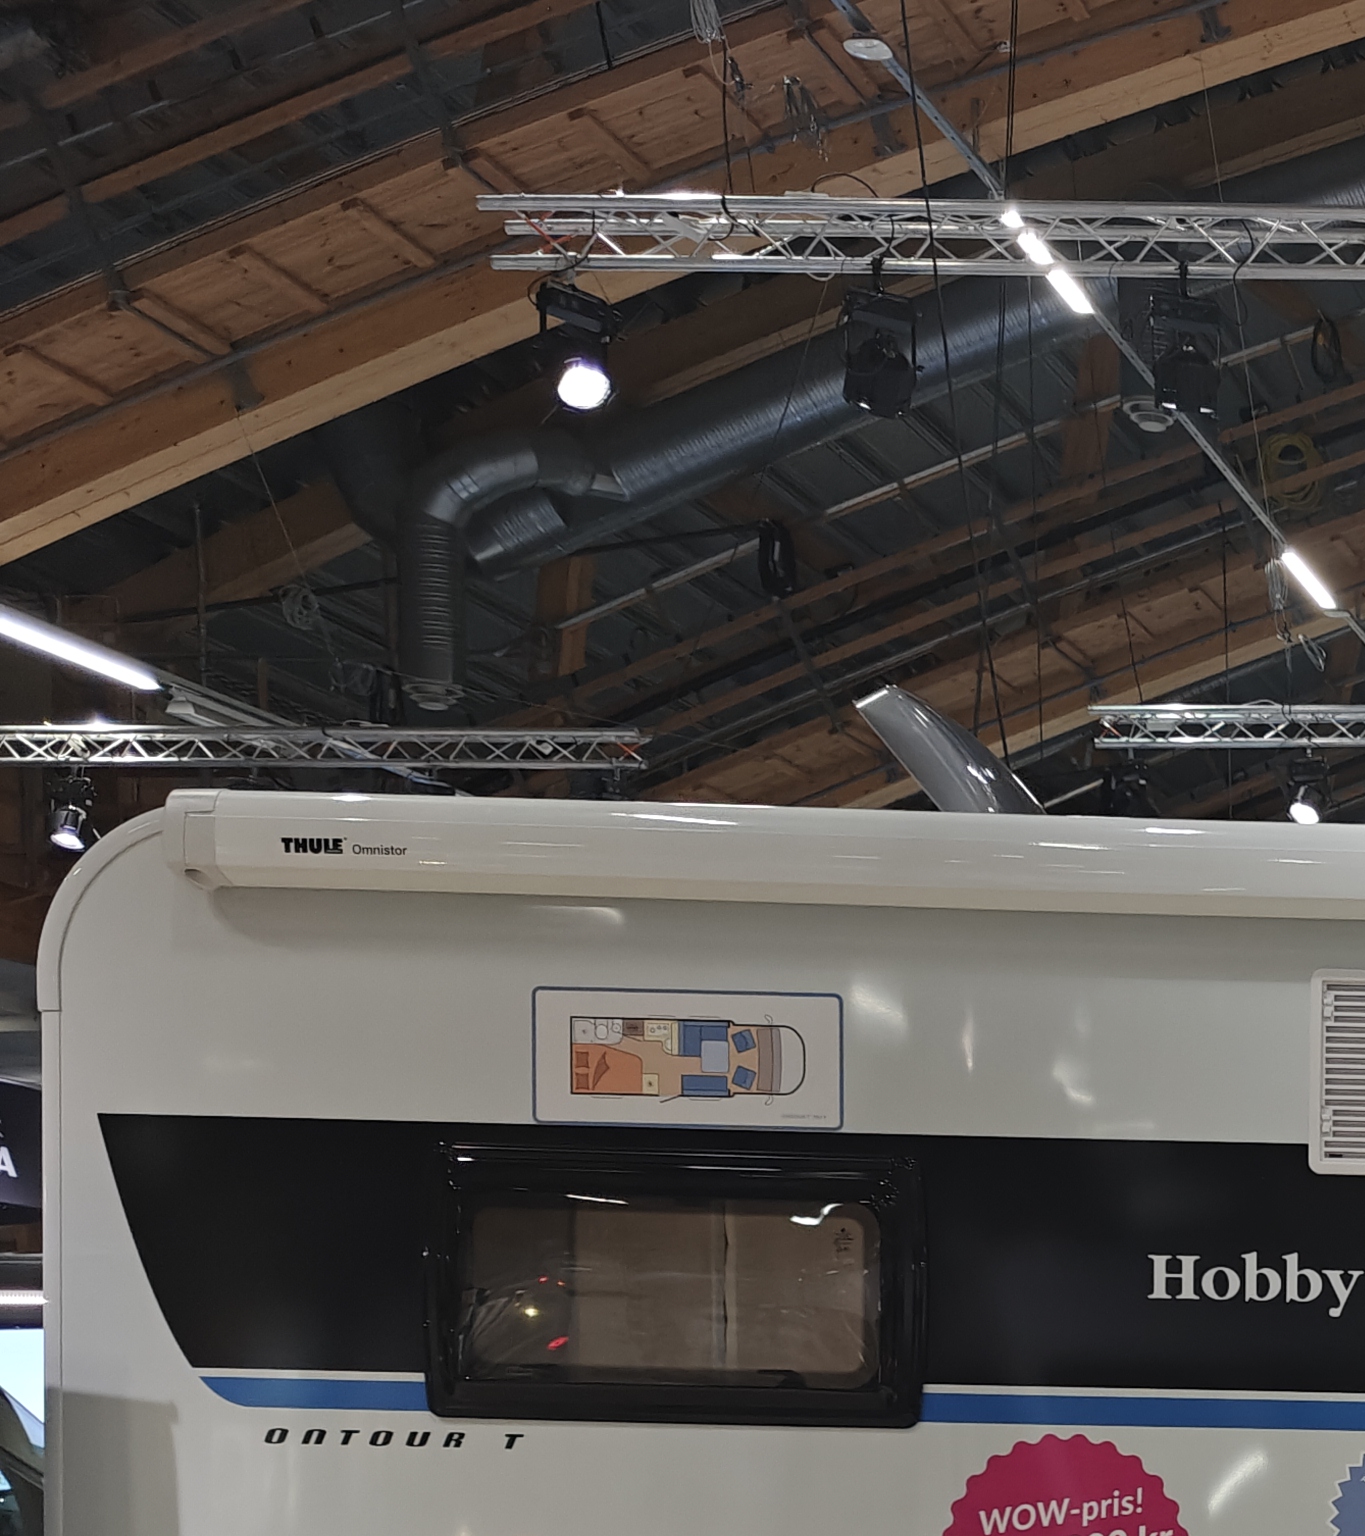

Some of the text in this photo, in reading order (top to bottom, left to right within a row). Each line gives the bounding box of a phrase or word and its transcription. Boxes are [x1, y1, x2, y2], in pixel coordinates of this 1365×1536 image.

[281, 837, 407, 856] THULE Omnistor
[1147, 1251, 1365, 1318] Hobby
[264, 1428, 524, 1450] ONTOUR T
[978, 1487, 1143, 1536] WOW-pris!
